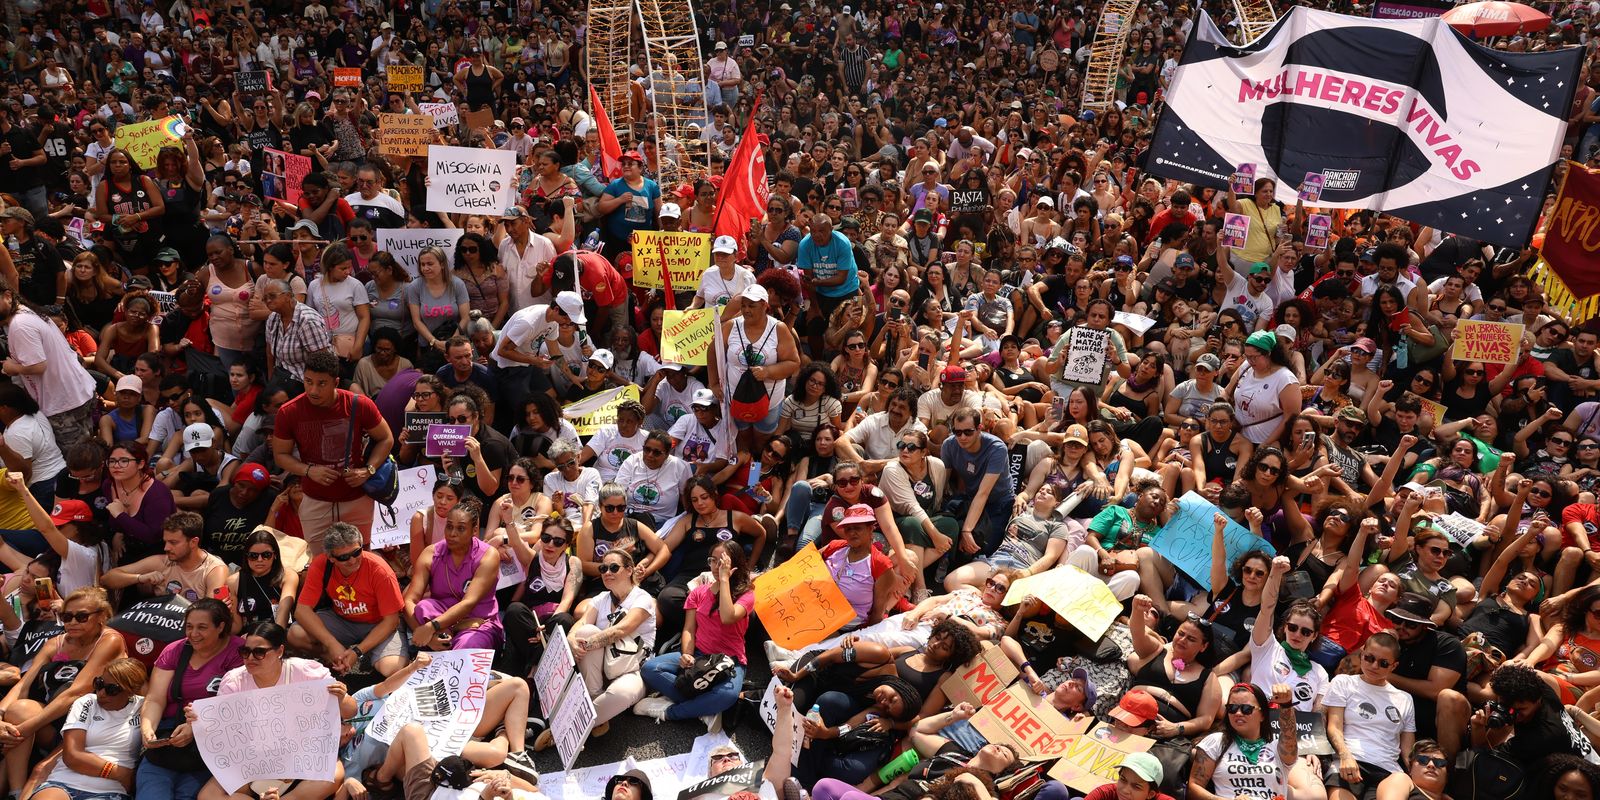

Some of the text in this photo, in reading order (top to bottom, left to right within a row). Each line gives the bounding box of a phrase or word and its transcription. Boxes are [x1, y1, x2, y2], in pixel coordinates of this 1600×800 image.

[391, 67, 423, 75] MACHISMO
[388, 83, 423, 92] CAPITALISMO
[428, 104, 456, 117] TODAS
[413, 118, 424, 126] SE
[433, 115, 458, 127] VIVAS
[1238, 70, 1481, 180] MULHERES VIVAS
[116, 128, 124, 139] O
[43, 138, 67, 157] 46
[1324, 170, 1358, 181] BANCADA
[1323, 179, 1356, 189] EMINISTA
[455, 195, 496, 210] CHEGA!
[953, 191, 983, 204] BASTA
[633, 232, 702, 247] O MACHISMO
[1225, 229, 1244, 238] MATA.
[1310, 229, 1326, 238] MATA.
[386, 238, 452, 251] MULHERES
[643, 257, 691, 268] FASISMO
[663, 310, 706, 339] MULHERES
[1465, 324, 1476, 333] UM
[1077, 330, 1095, 339] PARE
[1476, 333, 1512, 342] MULHERES
[688, 341, 709, 358] LUTA
[1076, 339, 1102, 348] MATAR
[1466, 341, 1511, 353] VIVAS
[1073, 346, 1104, 354] MULHERES
[1474, 352, 1510, 362] LIVRES
[571, 415, 617, 426] MULHE
[403, 484, 416, 492] UM
[225, 517, 248, 529] THE
[211, 532, 250, 542] FUTUR
[132, 601, 162, 610] Nem
[765, 585, 796, 627] MATAR
[122, 611, 185, 631] a menos!
[414, 685, 438, 717] MATA
[201, 694, 286, 732] SOMOS
[963, 662, 1074, 755] MULHERES
[205, 711, 331, 753] GRITO DAS
[215, 746, 258, 769] QUE
[263, 738, 299, 757] NÃO
[1066, 735, 1126, 780] VIVA
[241, 755, 329, 780] MAIS AQUI
[1228, 765, 1273, 774] como
[688, 770, 753, 793] a menos!
[1229, 777, 1266, 788] uma
